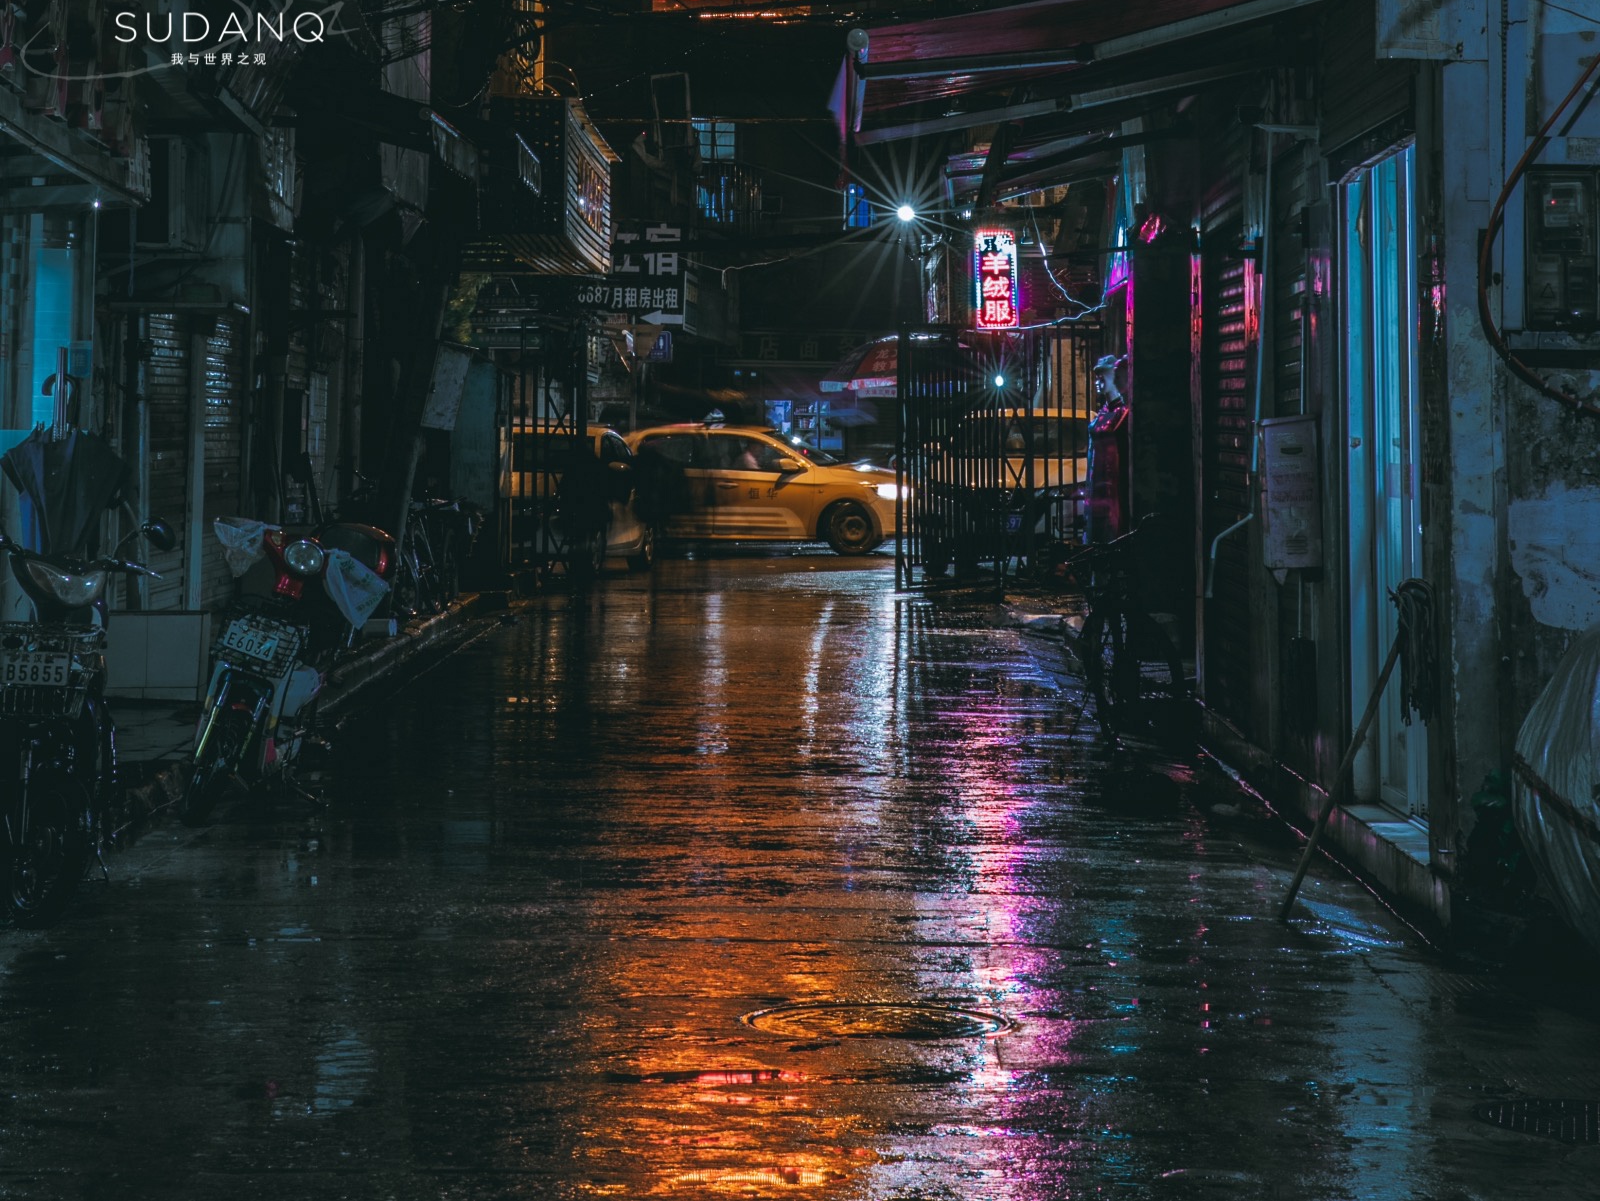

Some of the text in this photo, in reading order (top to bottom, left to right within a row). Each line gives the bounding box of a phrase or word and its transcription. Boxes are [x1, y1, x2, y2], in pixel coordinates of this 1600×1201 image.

[981, 252, 1011, 322] 羊绒服
[6, 664, 64, 683] B5855
